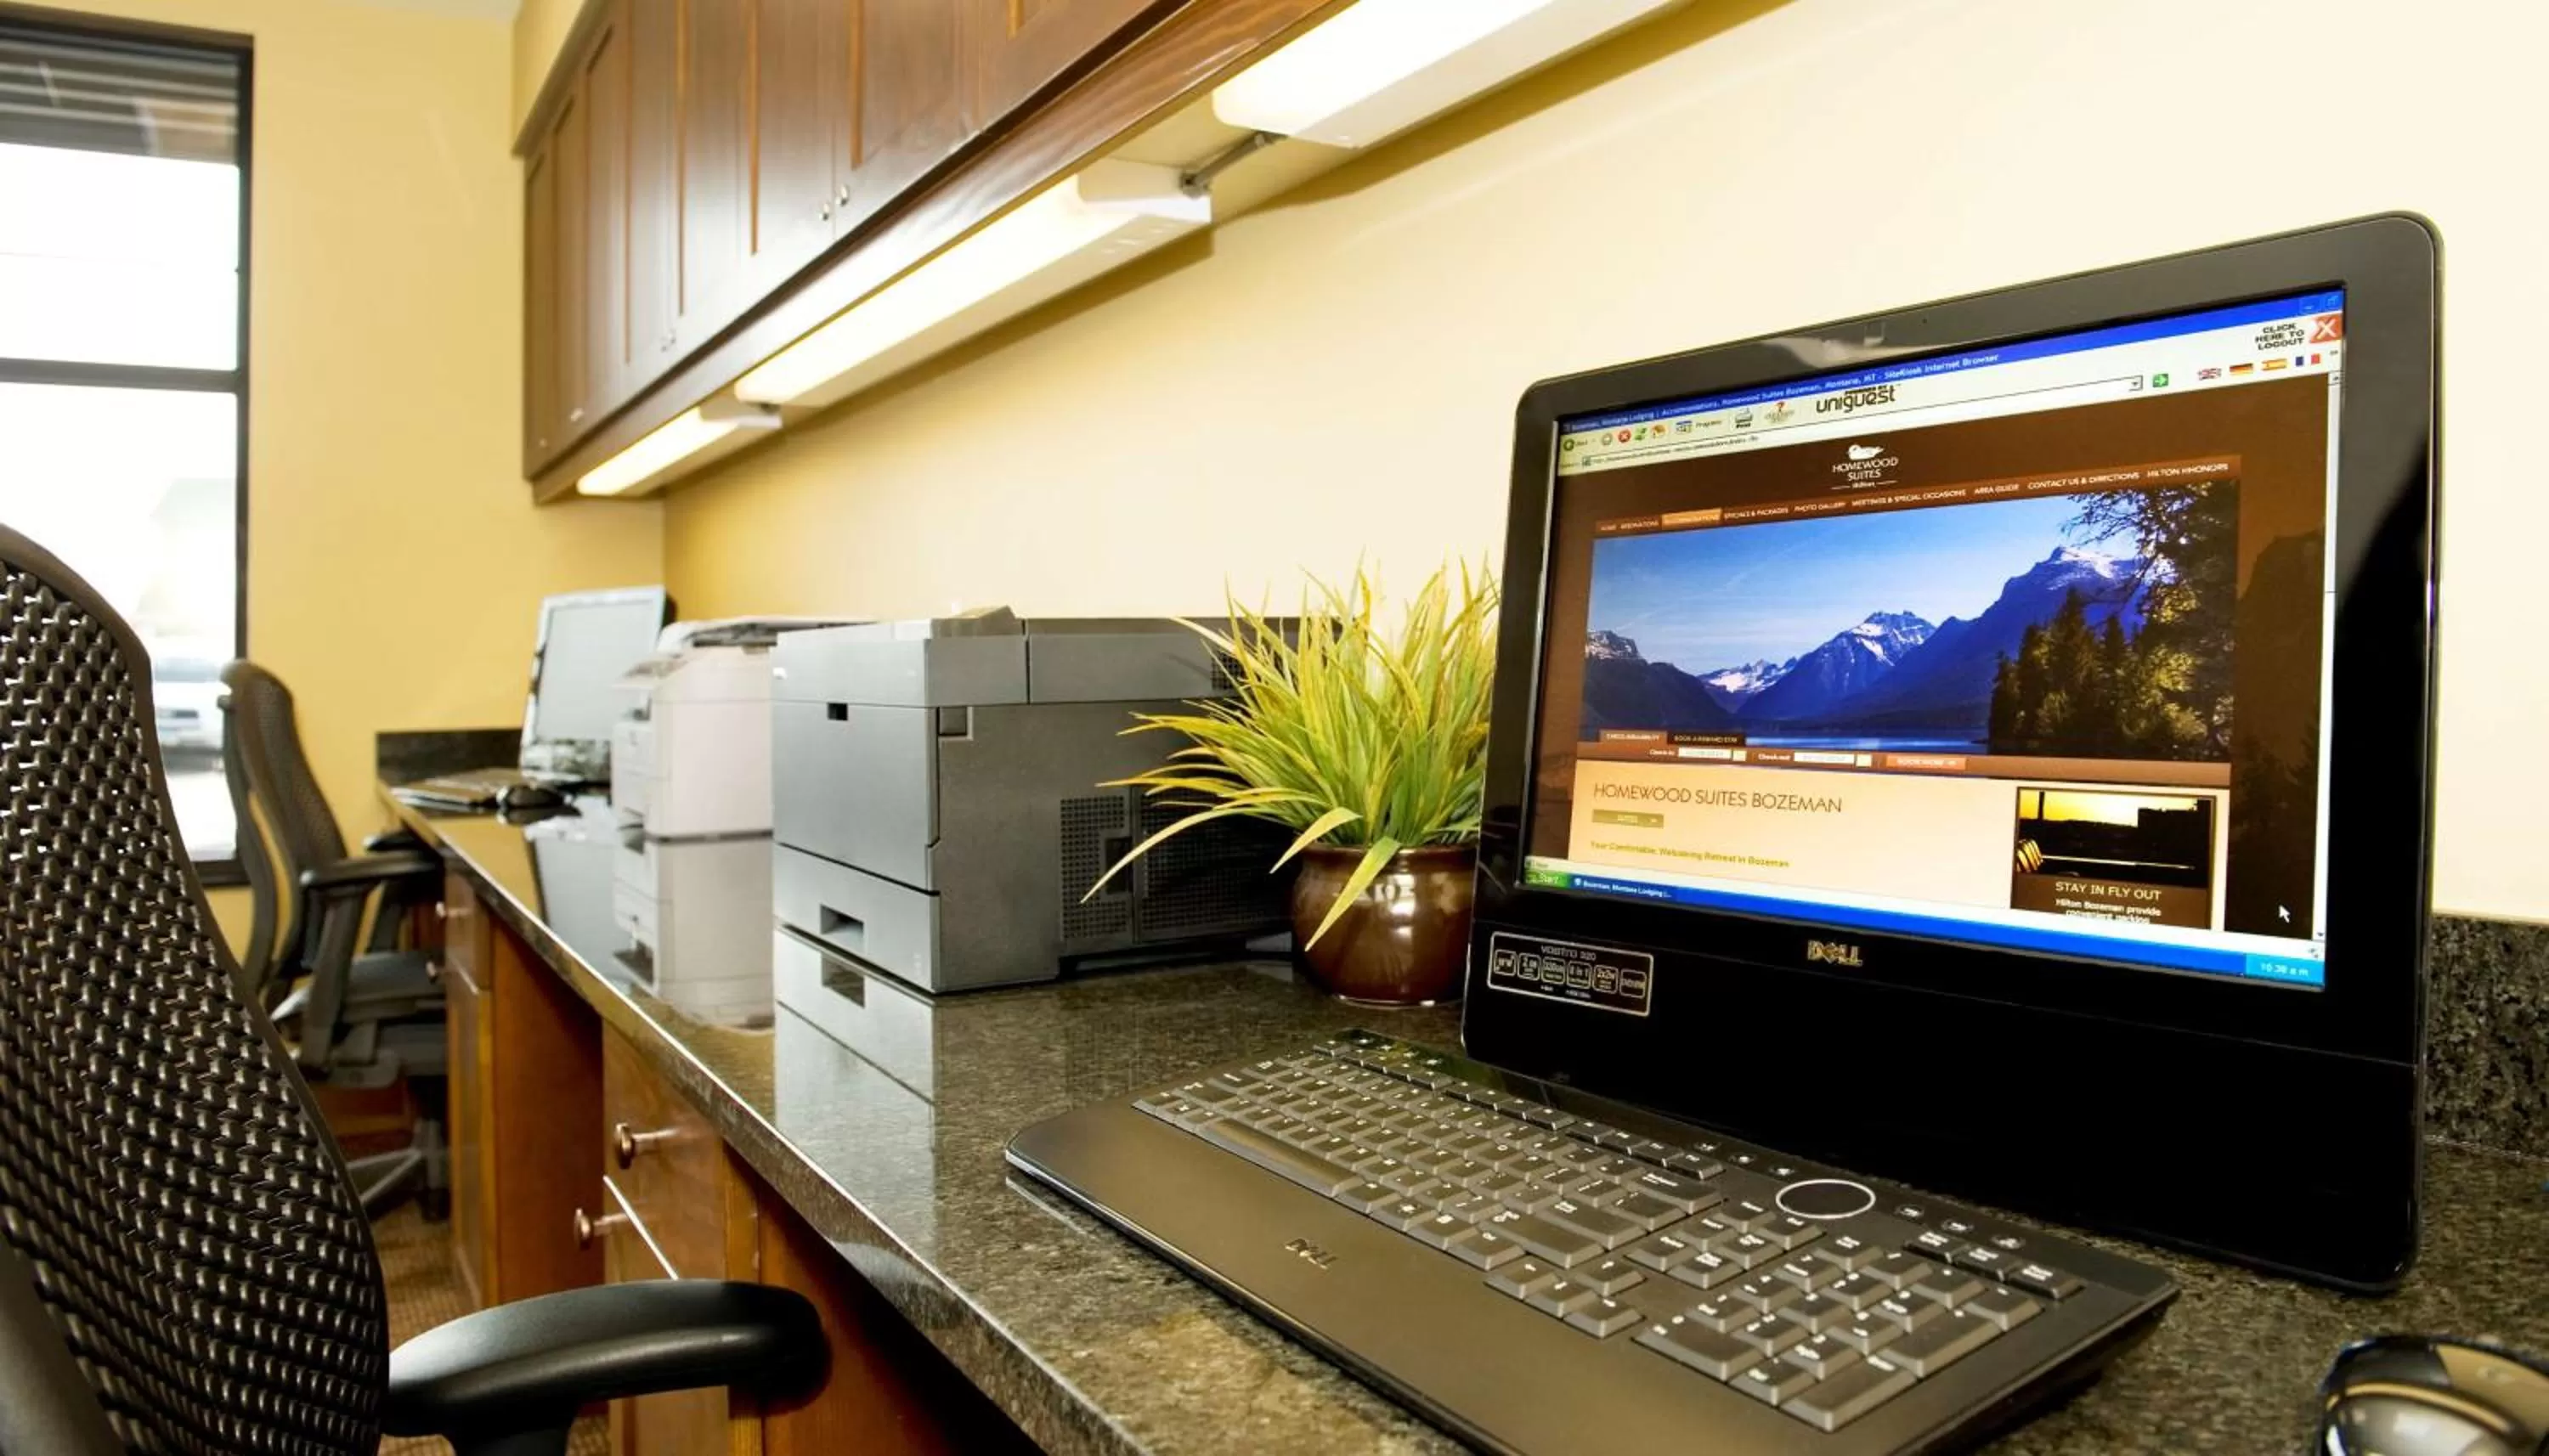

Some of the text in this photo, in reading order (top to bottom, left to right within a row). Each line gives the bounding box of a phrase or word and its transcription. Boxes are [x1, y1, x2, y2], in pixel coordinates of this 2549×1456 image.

[2255, 330, 2304, 343] HERE TO
[2263, 323, 2297, 333] CLICK
[2258, 338, 2304, 350] LOGOUT
[1924, 360, 1960, 373] Internet
[1962, 353, 1999, 368] Browser
[1815, 385, 1896, 413] uniguest
[1832, 456, 1899, 473] HOMEWOOD
[2147, 468, 2180, 478] HILTON
[1847, 469, 1882, 482] SUITES
[2027, 479, 2066, 490] CONTACT
[2067, 477, 2079, 487] US
[2088, 471, 2139, 484] DIRECTIONS
[1851, 496, 1886, 507] MEETINGS
[1893, 494, 1922, 503] SPECIAL
[1923, 488, 1967, 499] OCCASIONS
[1974, 486, 1994, 494] AREA
[1794, 504, 1817, 512] PHOTO
[1593, 782, 1843, 813] HOMEWOOD SUITES BOZEMAN
[1704, 851, 1737, 862] Retreat
[1748, 855, 1790, 867] Bozeman
[2055, 881, 2162, 900] STAY IN FLY OUT
[2055, 897, 2083, 908] Hilton
[2126, 906, 2162, 917] provide
[1807, 940, 1863, 968] DELL
[1284, 1238, 1337, 1271] DELL
